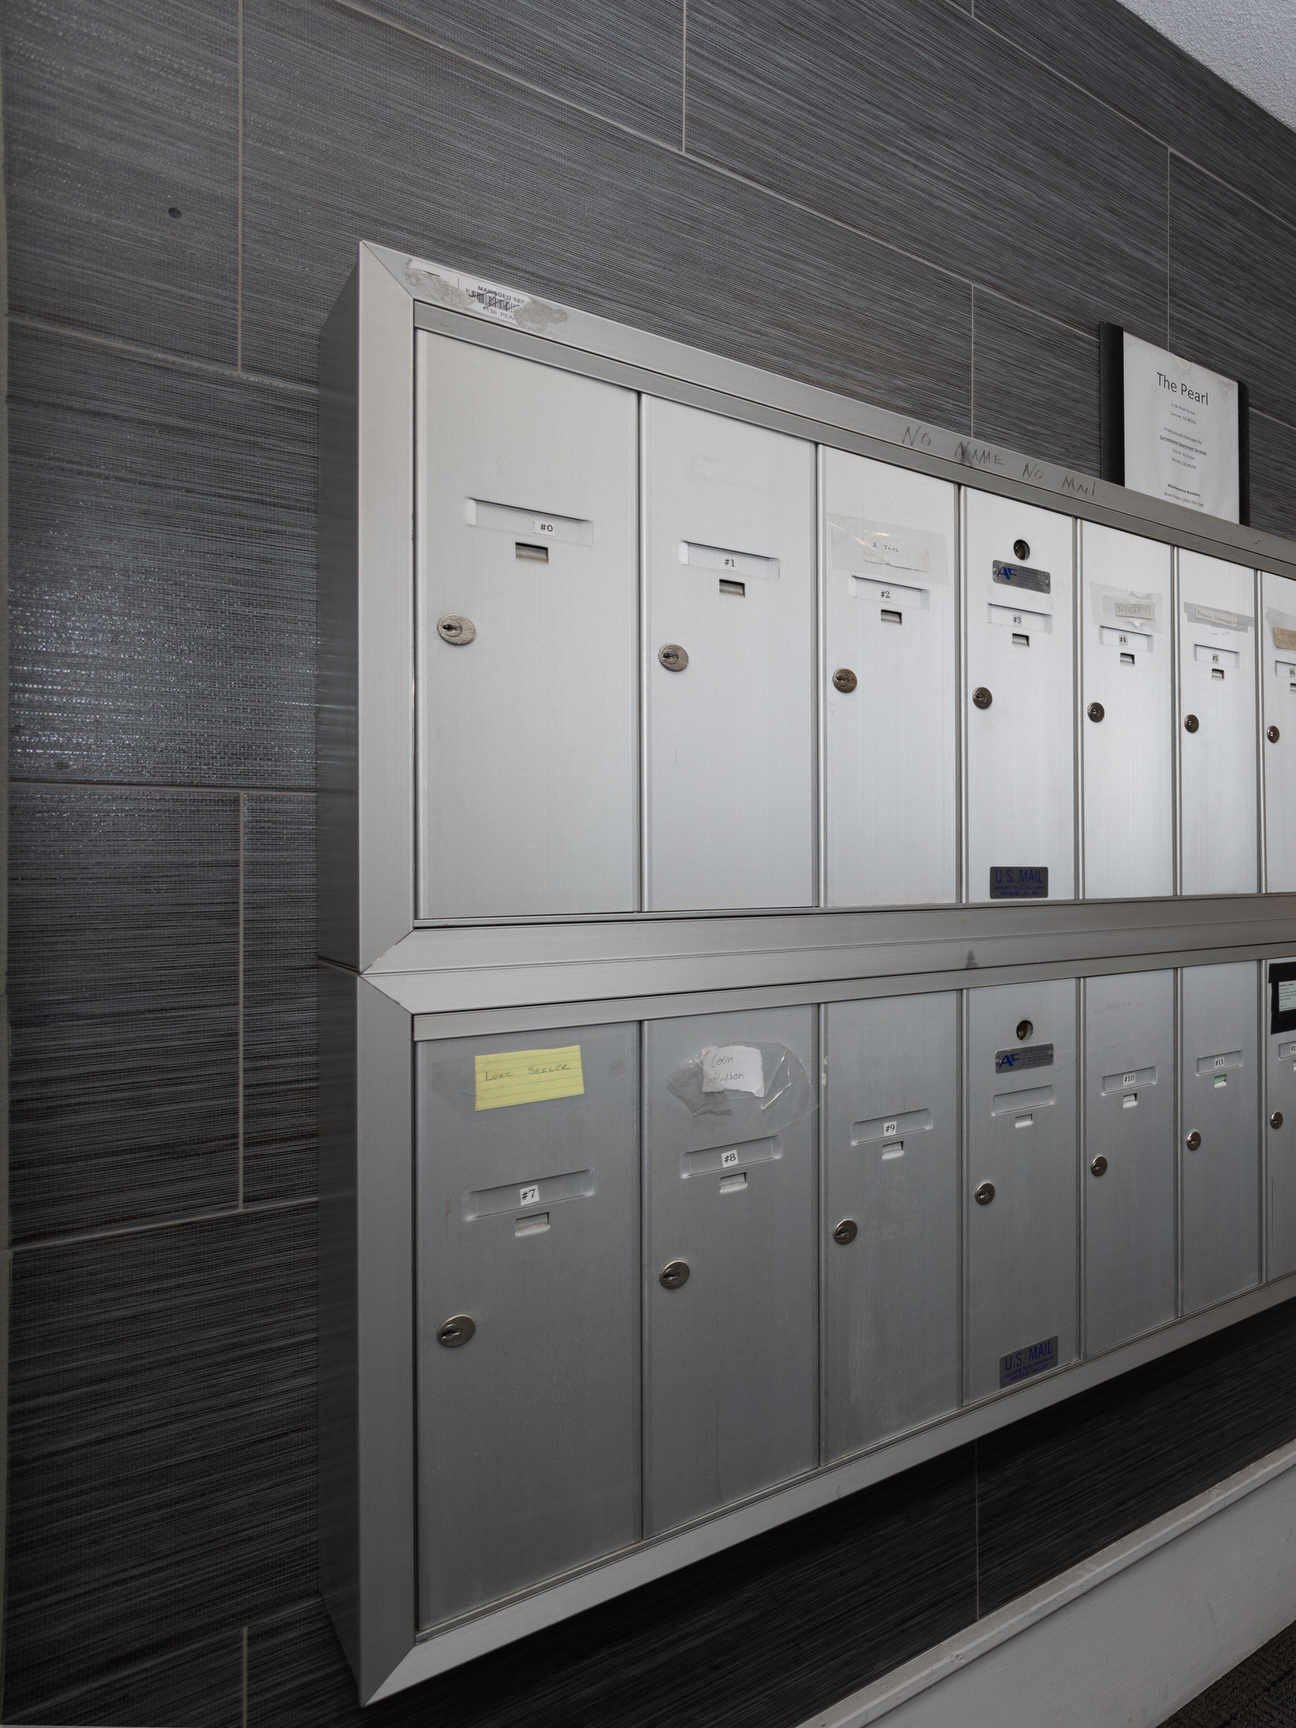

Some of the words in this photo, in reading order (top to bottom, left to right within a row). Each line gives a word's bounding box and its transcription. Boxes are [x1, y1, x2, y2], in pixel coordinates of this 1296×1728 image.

[1156, 371, 1178, 393] The
[1180, 383, 1209, 406] Pearl
[540, 523, 554, 533] #0
[1017, 868, 1043, 884] MAIL
[885, 1123, 896, 1133] #9
[723, 1152, 737, 1163] #8
[521, 1188, 537, 1201] #7
[1027, 1341, 1053, 1361] MAIL
